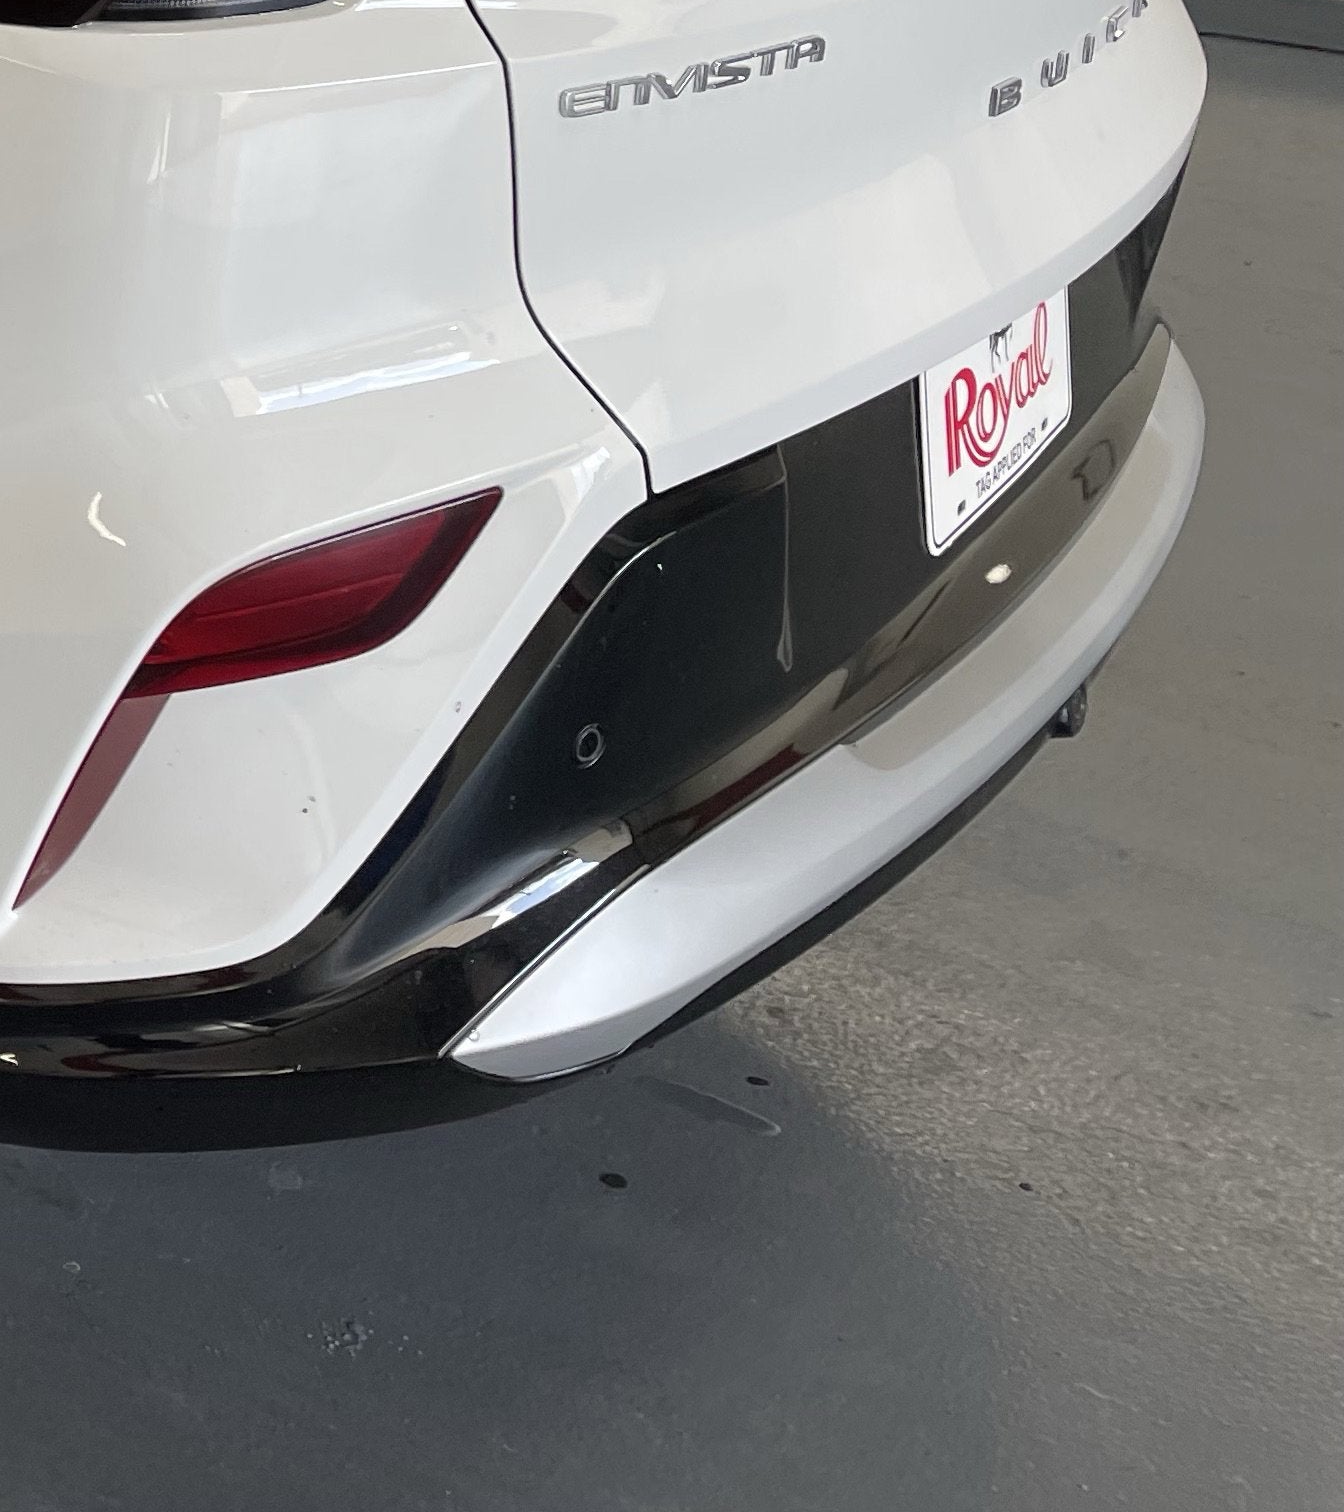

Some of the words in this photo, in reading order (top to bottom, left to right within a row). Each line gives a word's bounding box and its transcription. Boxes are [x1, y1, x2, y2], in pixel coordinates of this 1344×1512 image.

[558, 34, 826, 119] ENVISTA
[944, 301, 1053, 477] Royal
[975, 471, 992, 498] TAG
[993, 442, 1022, 481] APPLIED
[1022, 427, 1036, 454] FOR
